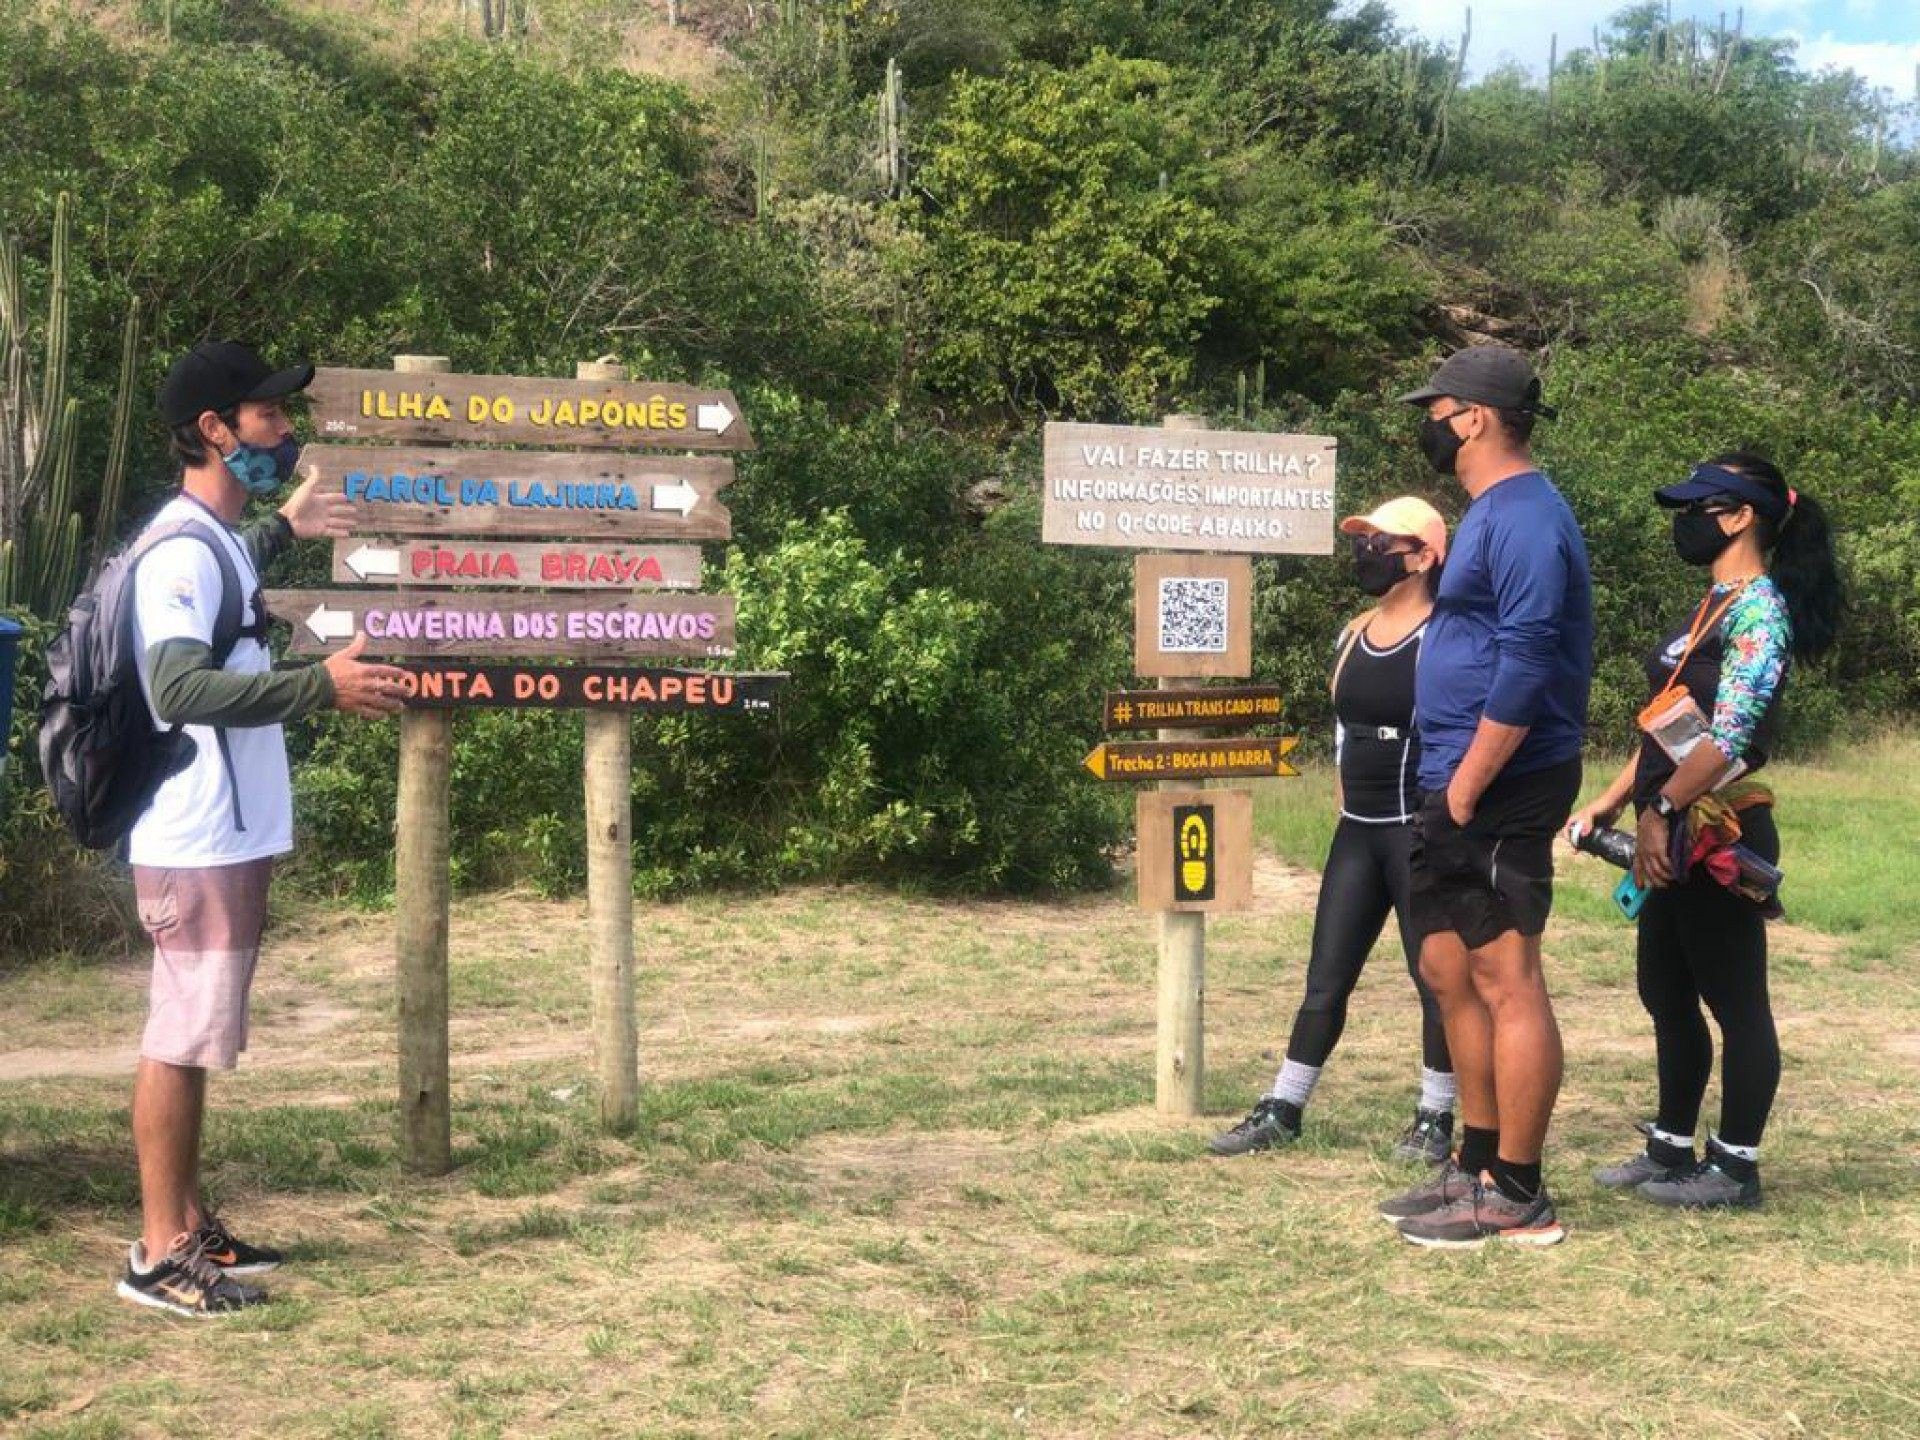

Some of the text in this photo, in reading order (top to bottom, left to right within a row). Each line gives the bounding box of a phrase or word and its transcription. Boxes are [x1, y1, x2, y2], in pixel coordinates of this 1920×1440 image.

[361, 389, 687, 429] ILHA DO JAPONÊS
[1082, 445, 1125, 468] VAI
[1137, 447, 1210, 471] FAZER
[344, 472, 638, 510] FAROL DA LAJINHA
[1054, 478, 1333, 510] INFORMAÇÕES IMPORTANTES
[1077, 510, 1105, 531] NO
[411, 549, 663, 582] PRAIA BRAVA
[364, 609, 717, 642] CAVERNA DOS ESCRAVOS
[397, 670, 734, 705] ONTA DO CHAPÉU
[1137, 701, 1184, 719] TRILHA
[1109, 754, 1154, 773] Trecho
[1173, 751, 1208, 769] BOCA
[1210, 750, 1227, 768] DA
[1228, 748, 1273, 767] BARRA
